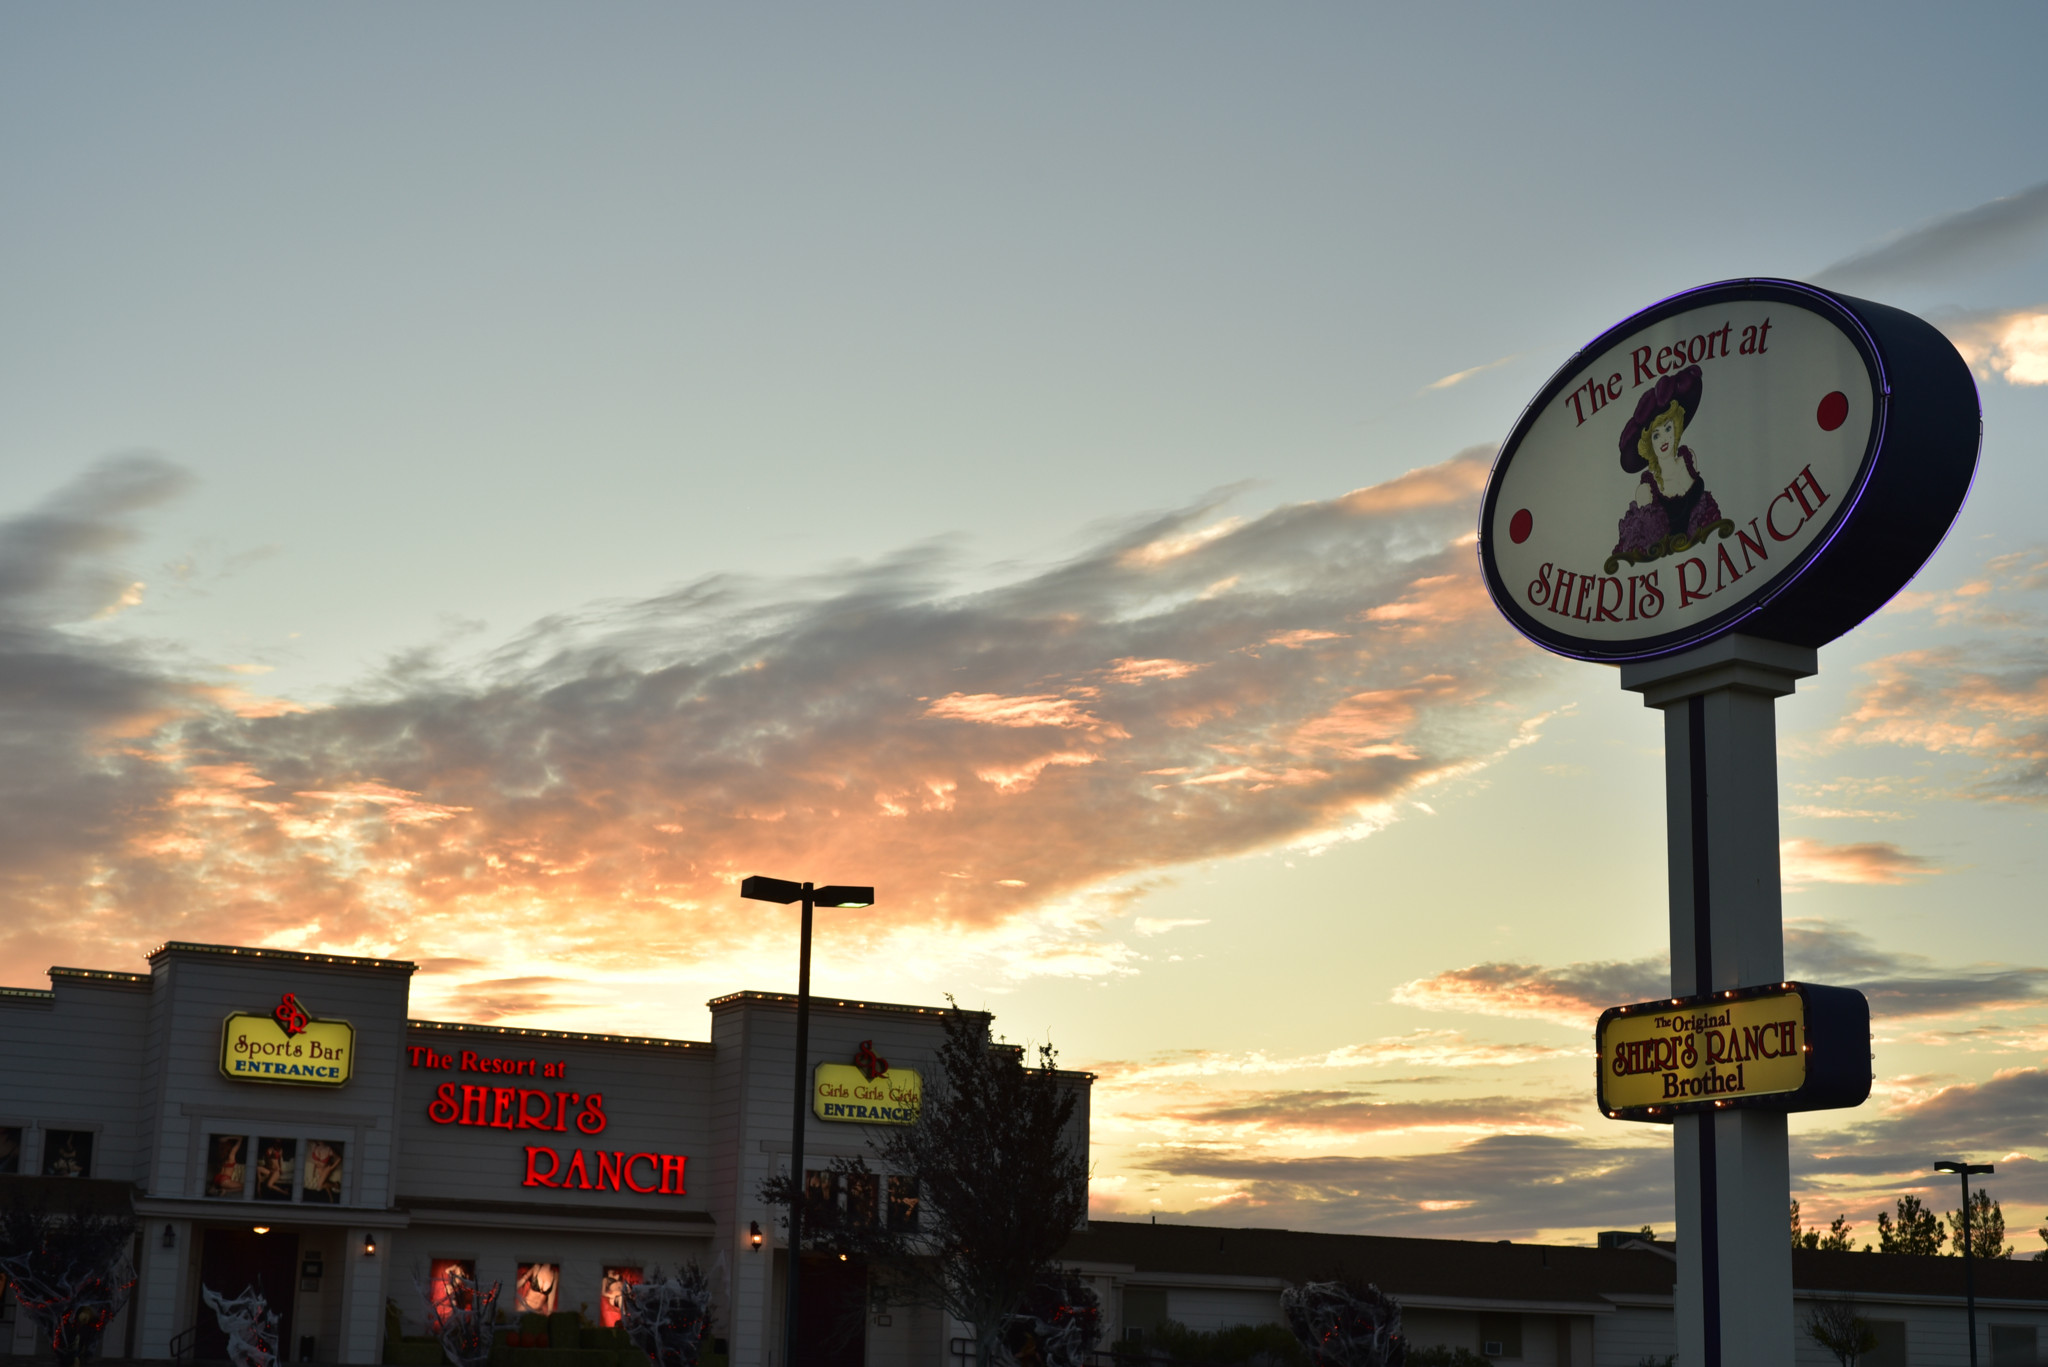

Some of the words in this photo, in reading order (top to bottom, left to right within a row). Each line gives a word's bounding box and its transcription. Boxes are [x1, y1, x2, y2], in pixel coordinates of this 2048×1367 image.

[1564, 371, 1623, 428] The
[1629, 320, 1733, 390] Resort
[1738, 317, 1773, 355] at
[1527, 561, 1665, 624] SHERI'S
[1675, 463, 1832, 609] RANCH
[1654, 1016, 1672, 1029] The
[1672, 1008, 1732, 1034] Original
[234, 1034, 303, 1060] Sports
[309, 1040, 343, 1061] Bar
[407, 1045, 453, 1070] The
[460, 1049, 537, 1077] Resort
[543, 1059, 567, 1079] at
[1612, 1031, 1699, 1077] SHERI'S
[1704, 1020, 1798, 1066] RANCH
[234, 1059, 340, 1078] ENTRANCE
[1661, 1062, 1746, 1099] Brothel
[427, 1081, 608, 1135] SHERI'S
[818, 1082, 850, 1099] Girls
[853, 1085, 885, 1101] Girls
[888, 1087, 920, 1104] Girls
[823, 1102, 914, 1121] ENTRANCE
[522, 1145, 689, 1196] RANCH
